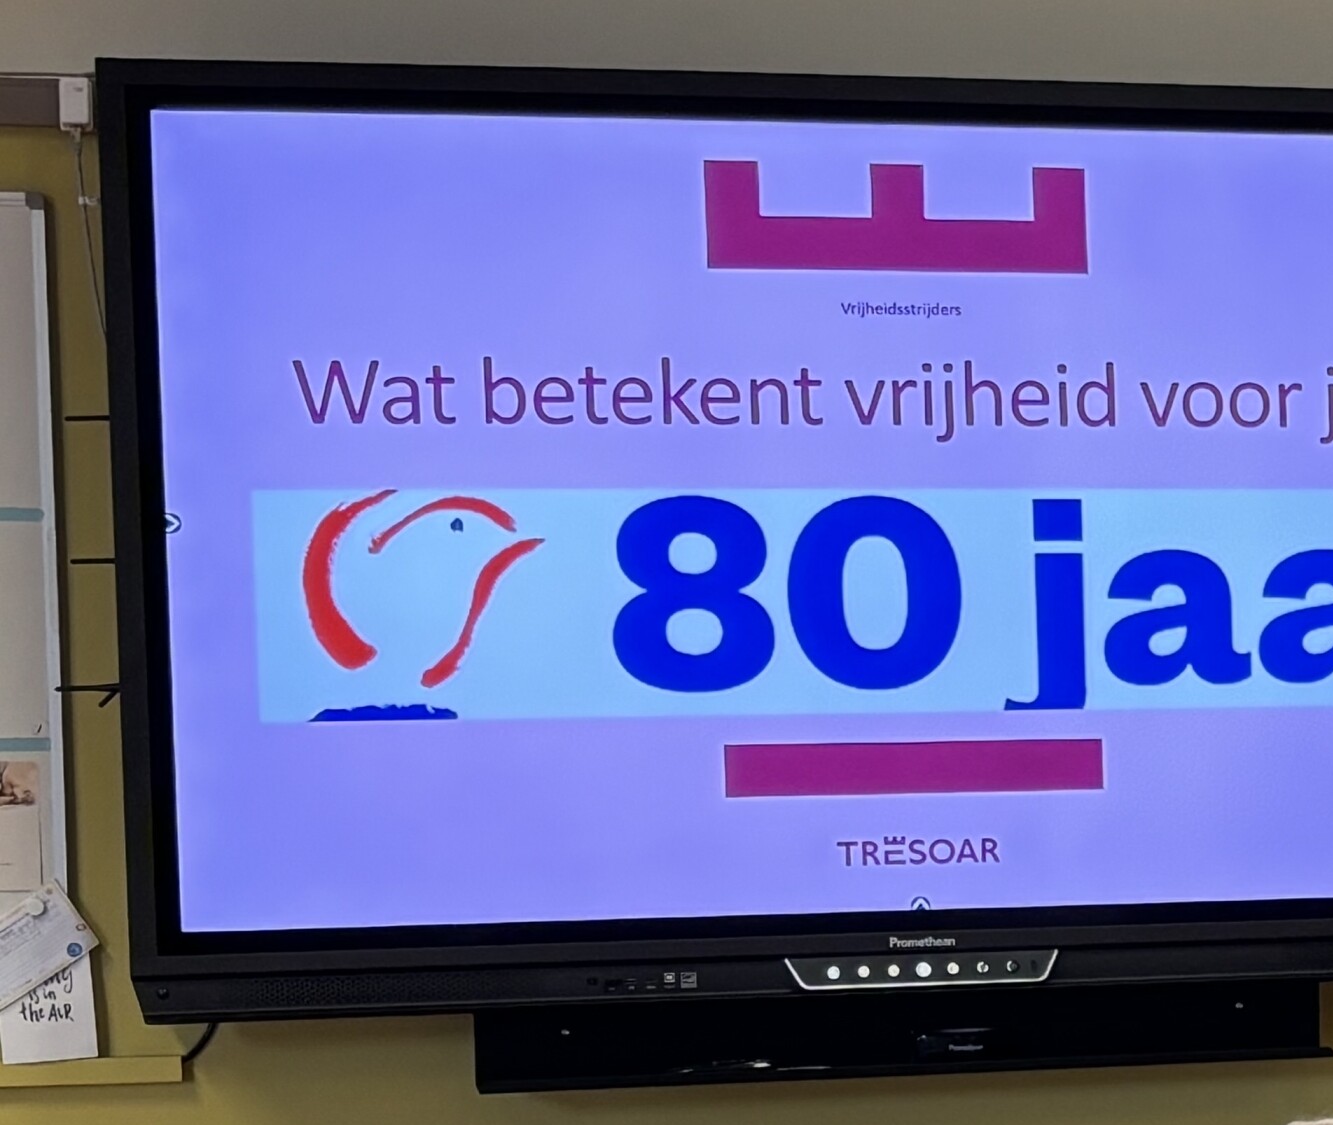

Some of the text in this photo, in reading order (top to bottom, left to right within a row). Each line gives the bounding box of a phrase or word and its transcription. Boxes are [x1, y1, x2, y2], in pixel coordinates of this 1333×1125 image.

[841, 302, 962, 319] Vrijheidsstrijders
[292, 359, 457, 425] Wat
[482, 355, 823, 426] betekent
[843, 359, 1116, 443] vrijheid
[1139, 381, 1303, 428] voor
[612, 494, 962, 692] 80
[889, 936, 955, 948] Promethean
[20, 1002, 45, 1023] the
